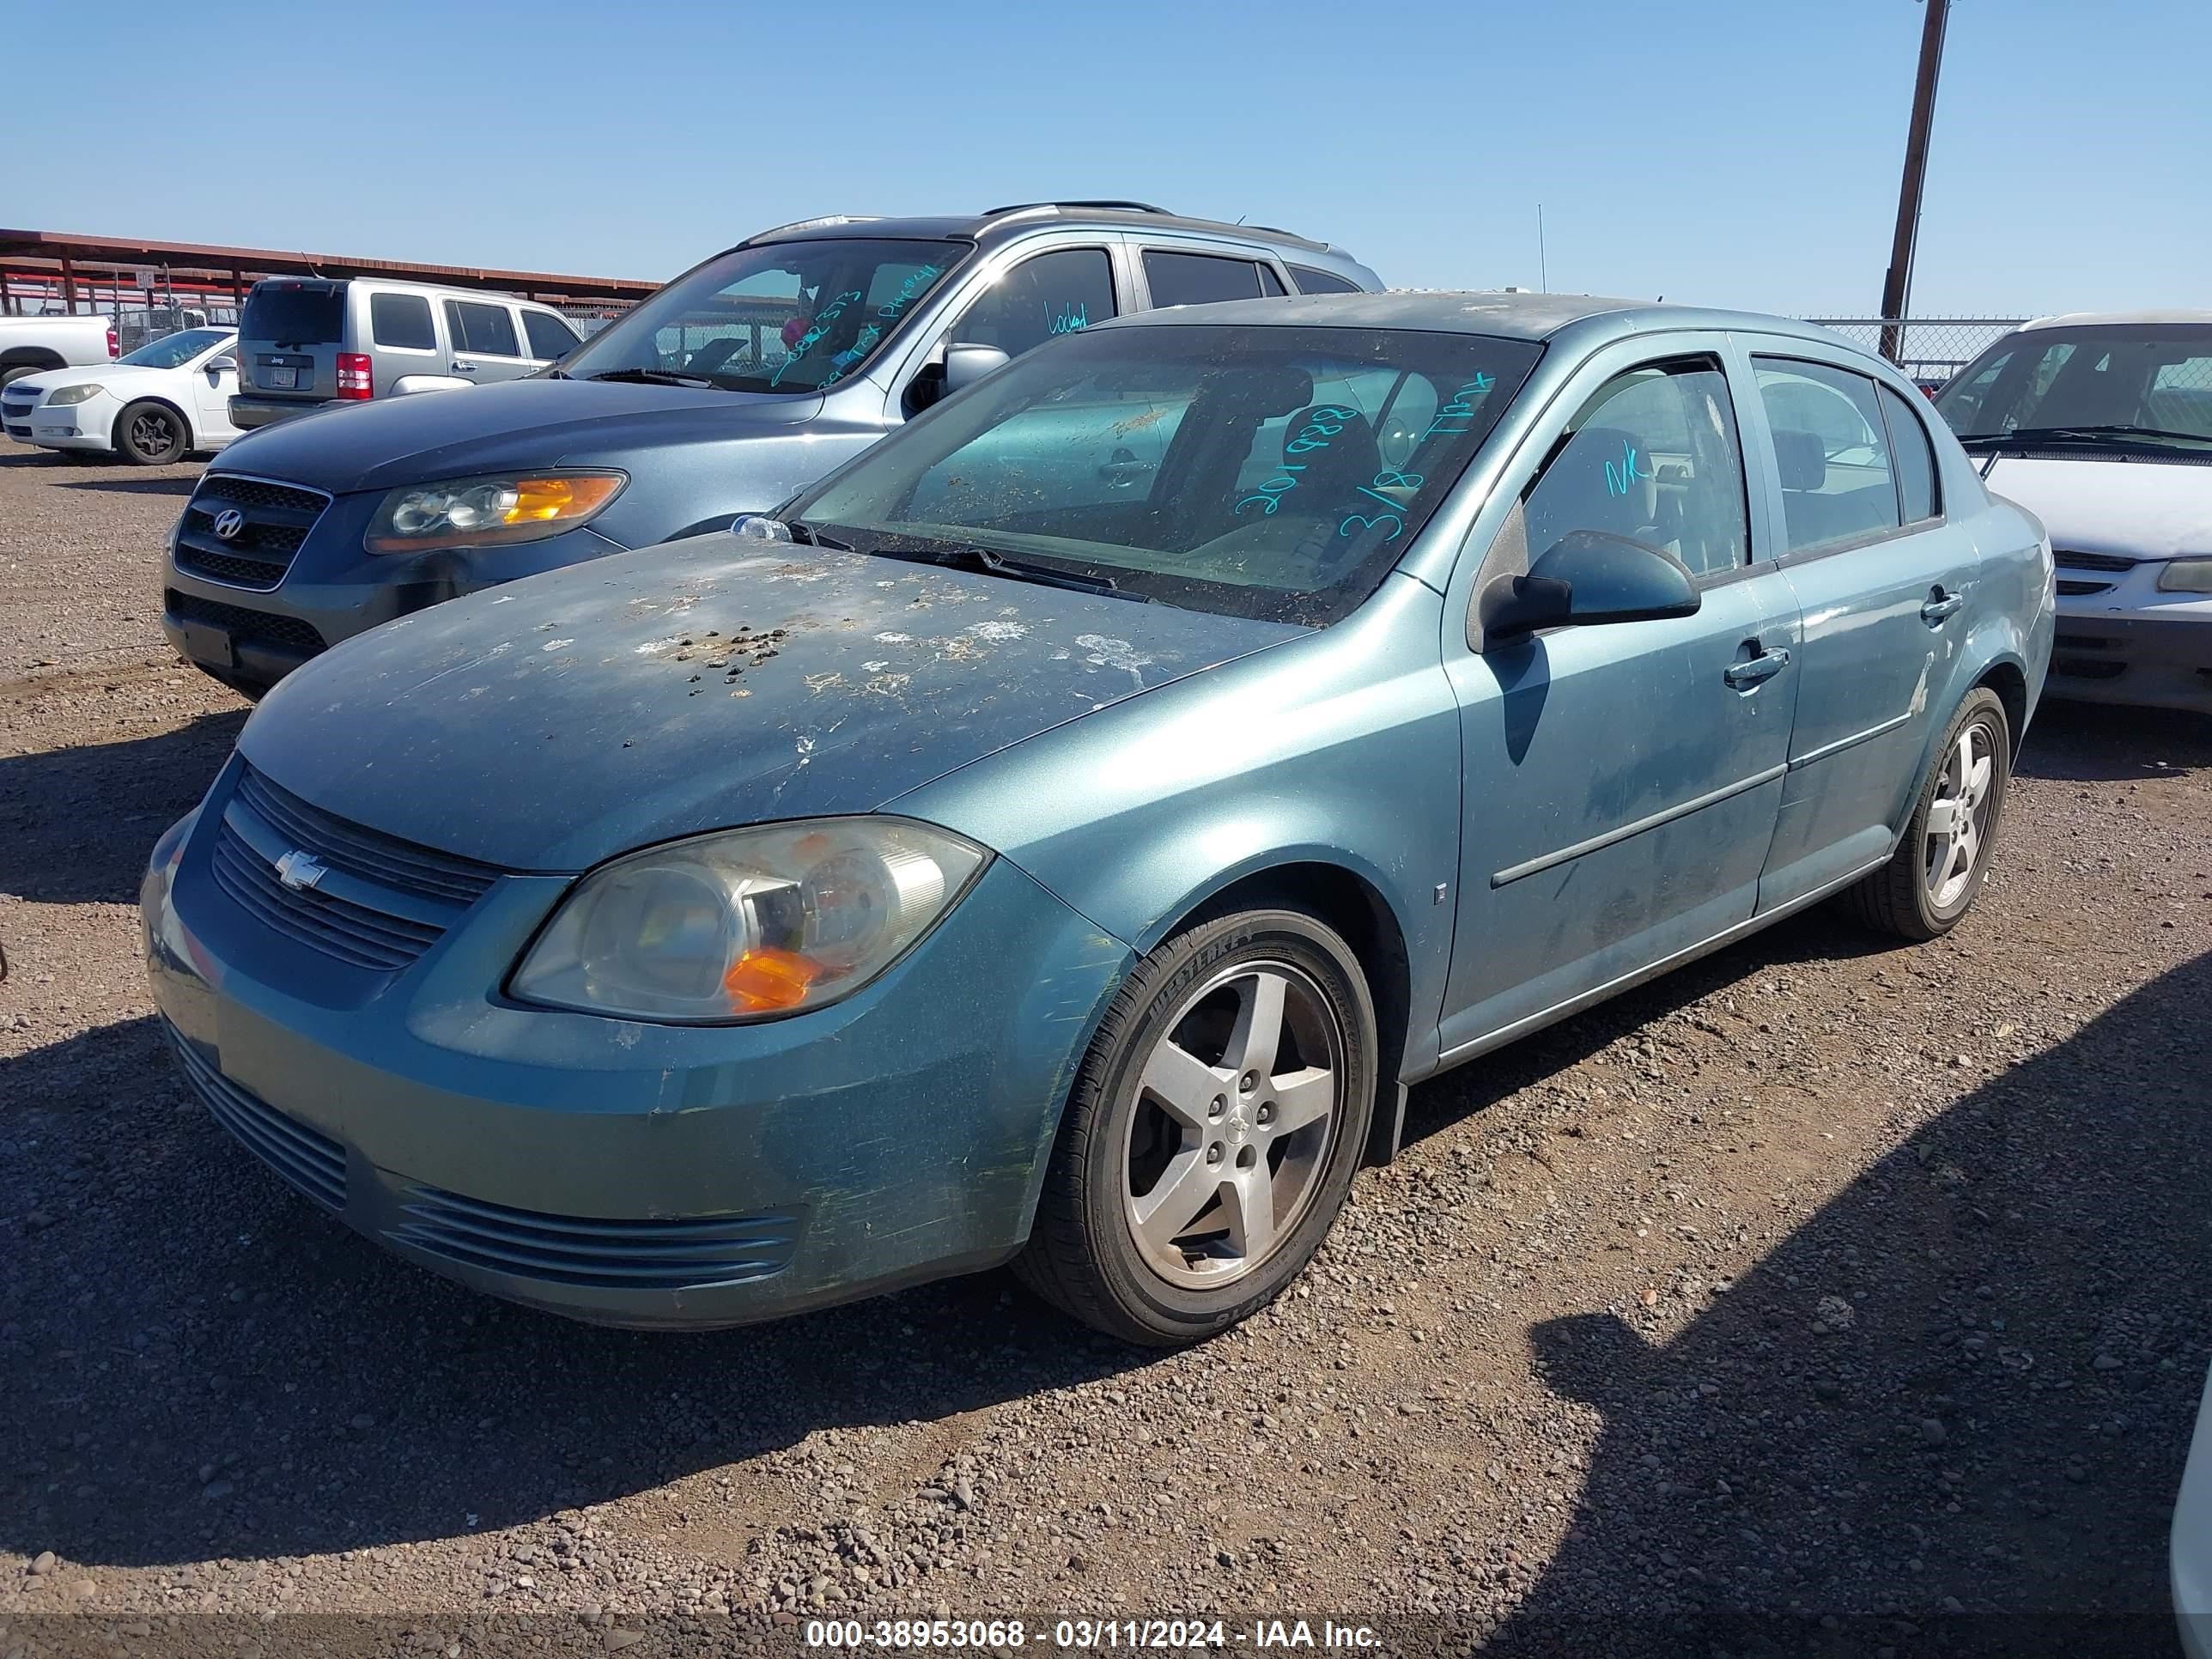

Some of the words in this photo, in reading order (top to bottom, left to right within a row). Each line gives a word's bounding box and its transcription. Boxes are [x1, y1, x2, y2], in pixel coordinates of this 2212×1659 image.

[271, 356, 284, 365] Jeep
[1604, 439, 1650, 497] NK
[1340, 471, 1424, 541] 3/8
